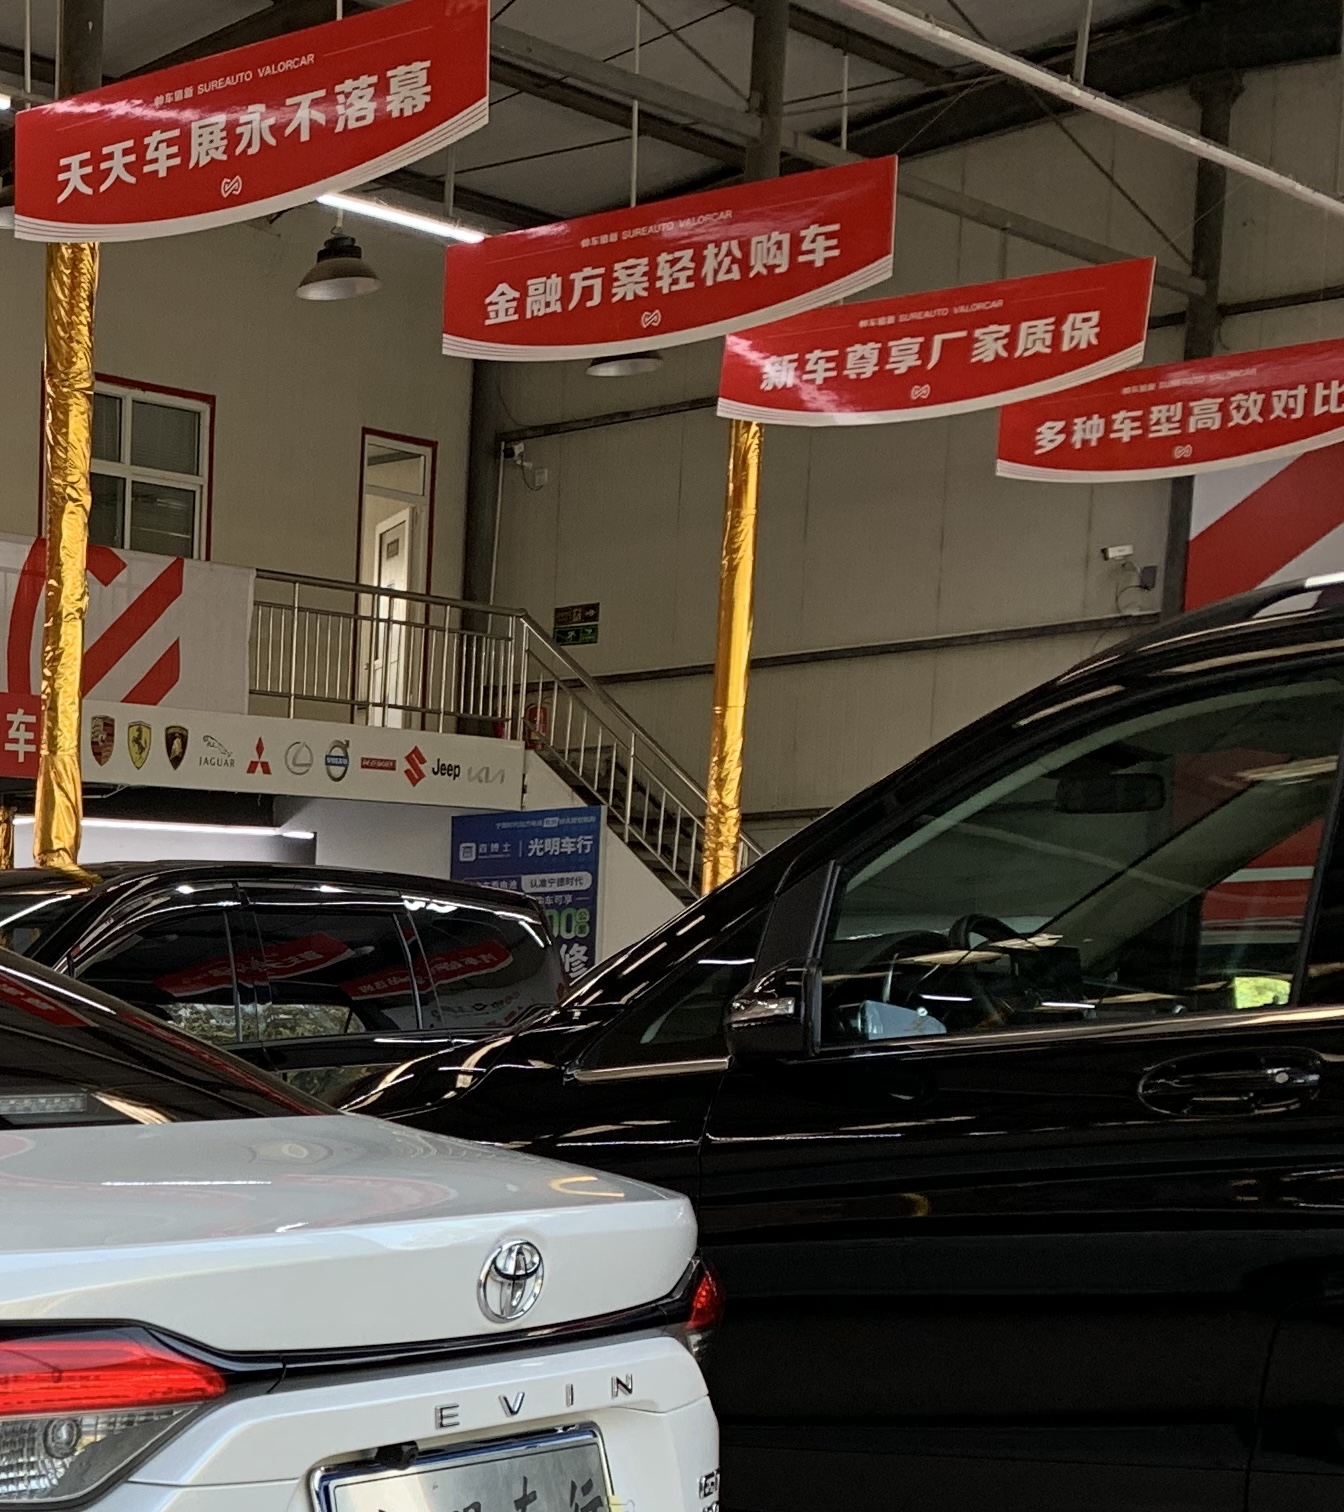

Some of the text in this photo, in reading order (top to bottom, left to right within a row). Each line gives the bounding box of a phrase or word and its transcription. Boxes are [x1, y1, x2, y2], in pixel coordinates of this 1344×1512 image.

[197, 71, 253, 95] SUREAUTO
[257, 54, 315, 78] VALORCAR
[57, 60, 431, 204] 天天车展永不落幕
[621, 221, 675, 240] SUREAUTO
[678, 209, 733, 228] VALORCAR
[484, 222, 842, 326] 金融方案轻松购车
[759, 309, 1102, 392] 新车尊享厂家质保
[1034, 380, 1344, 456] 多种车型高效对比
[198, 754, 236, 768] JAGUAR
[432, 758, 461, 781] Jeep
[527, 835, 593, 857] 光明车行
